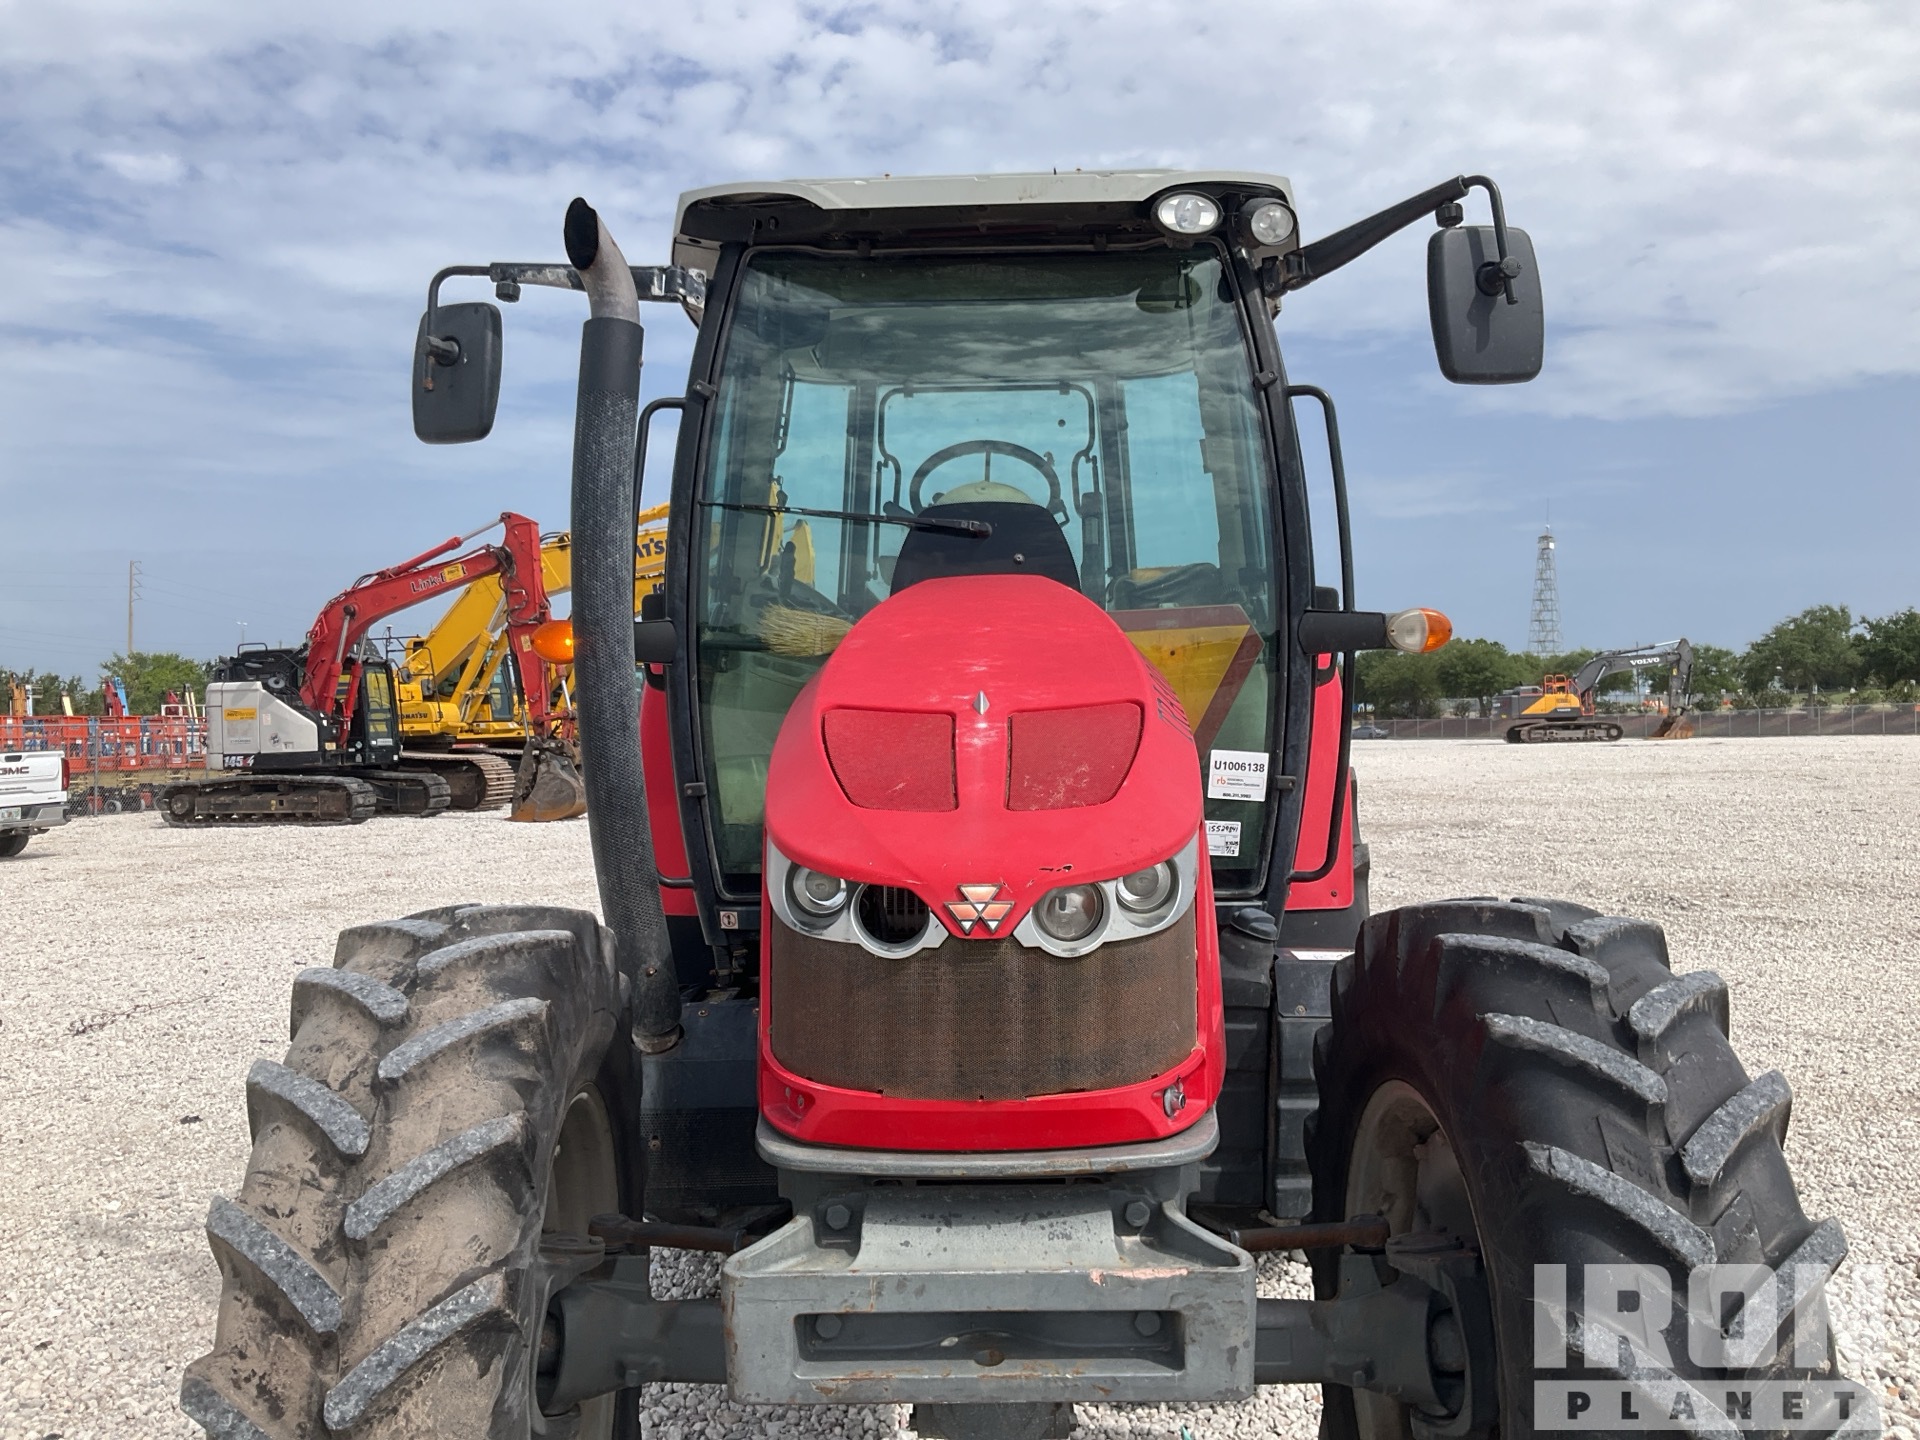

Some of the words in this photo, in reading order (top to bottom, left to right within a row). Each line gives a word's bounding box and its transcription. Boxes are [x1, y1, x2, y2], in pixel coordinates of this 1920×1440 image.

[1630, 657, 1660, 665] VOLVO
[0, 766, 29, 775] GMC
[1214, 760, 1265, 772] U1006138
[1216, 776, 1226, 785] rb
